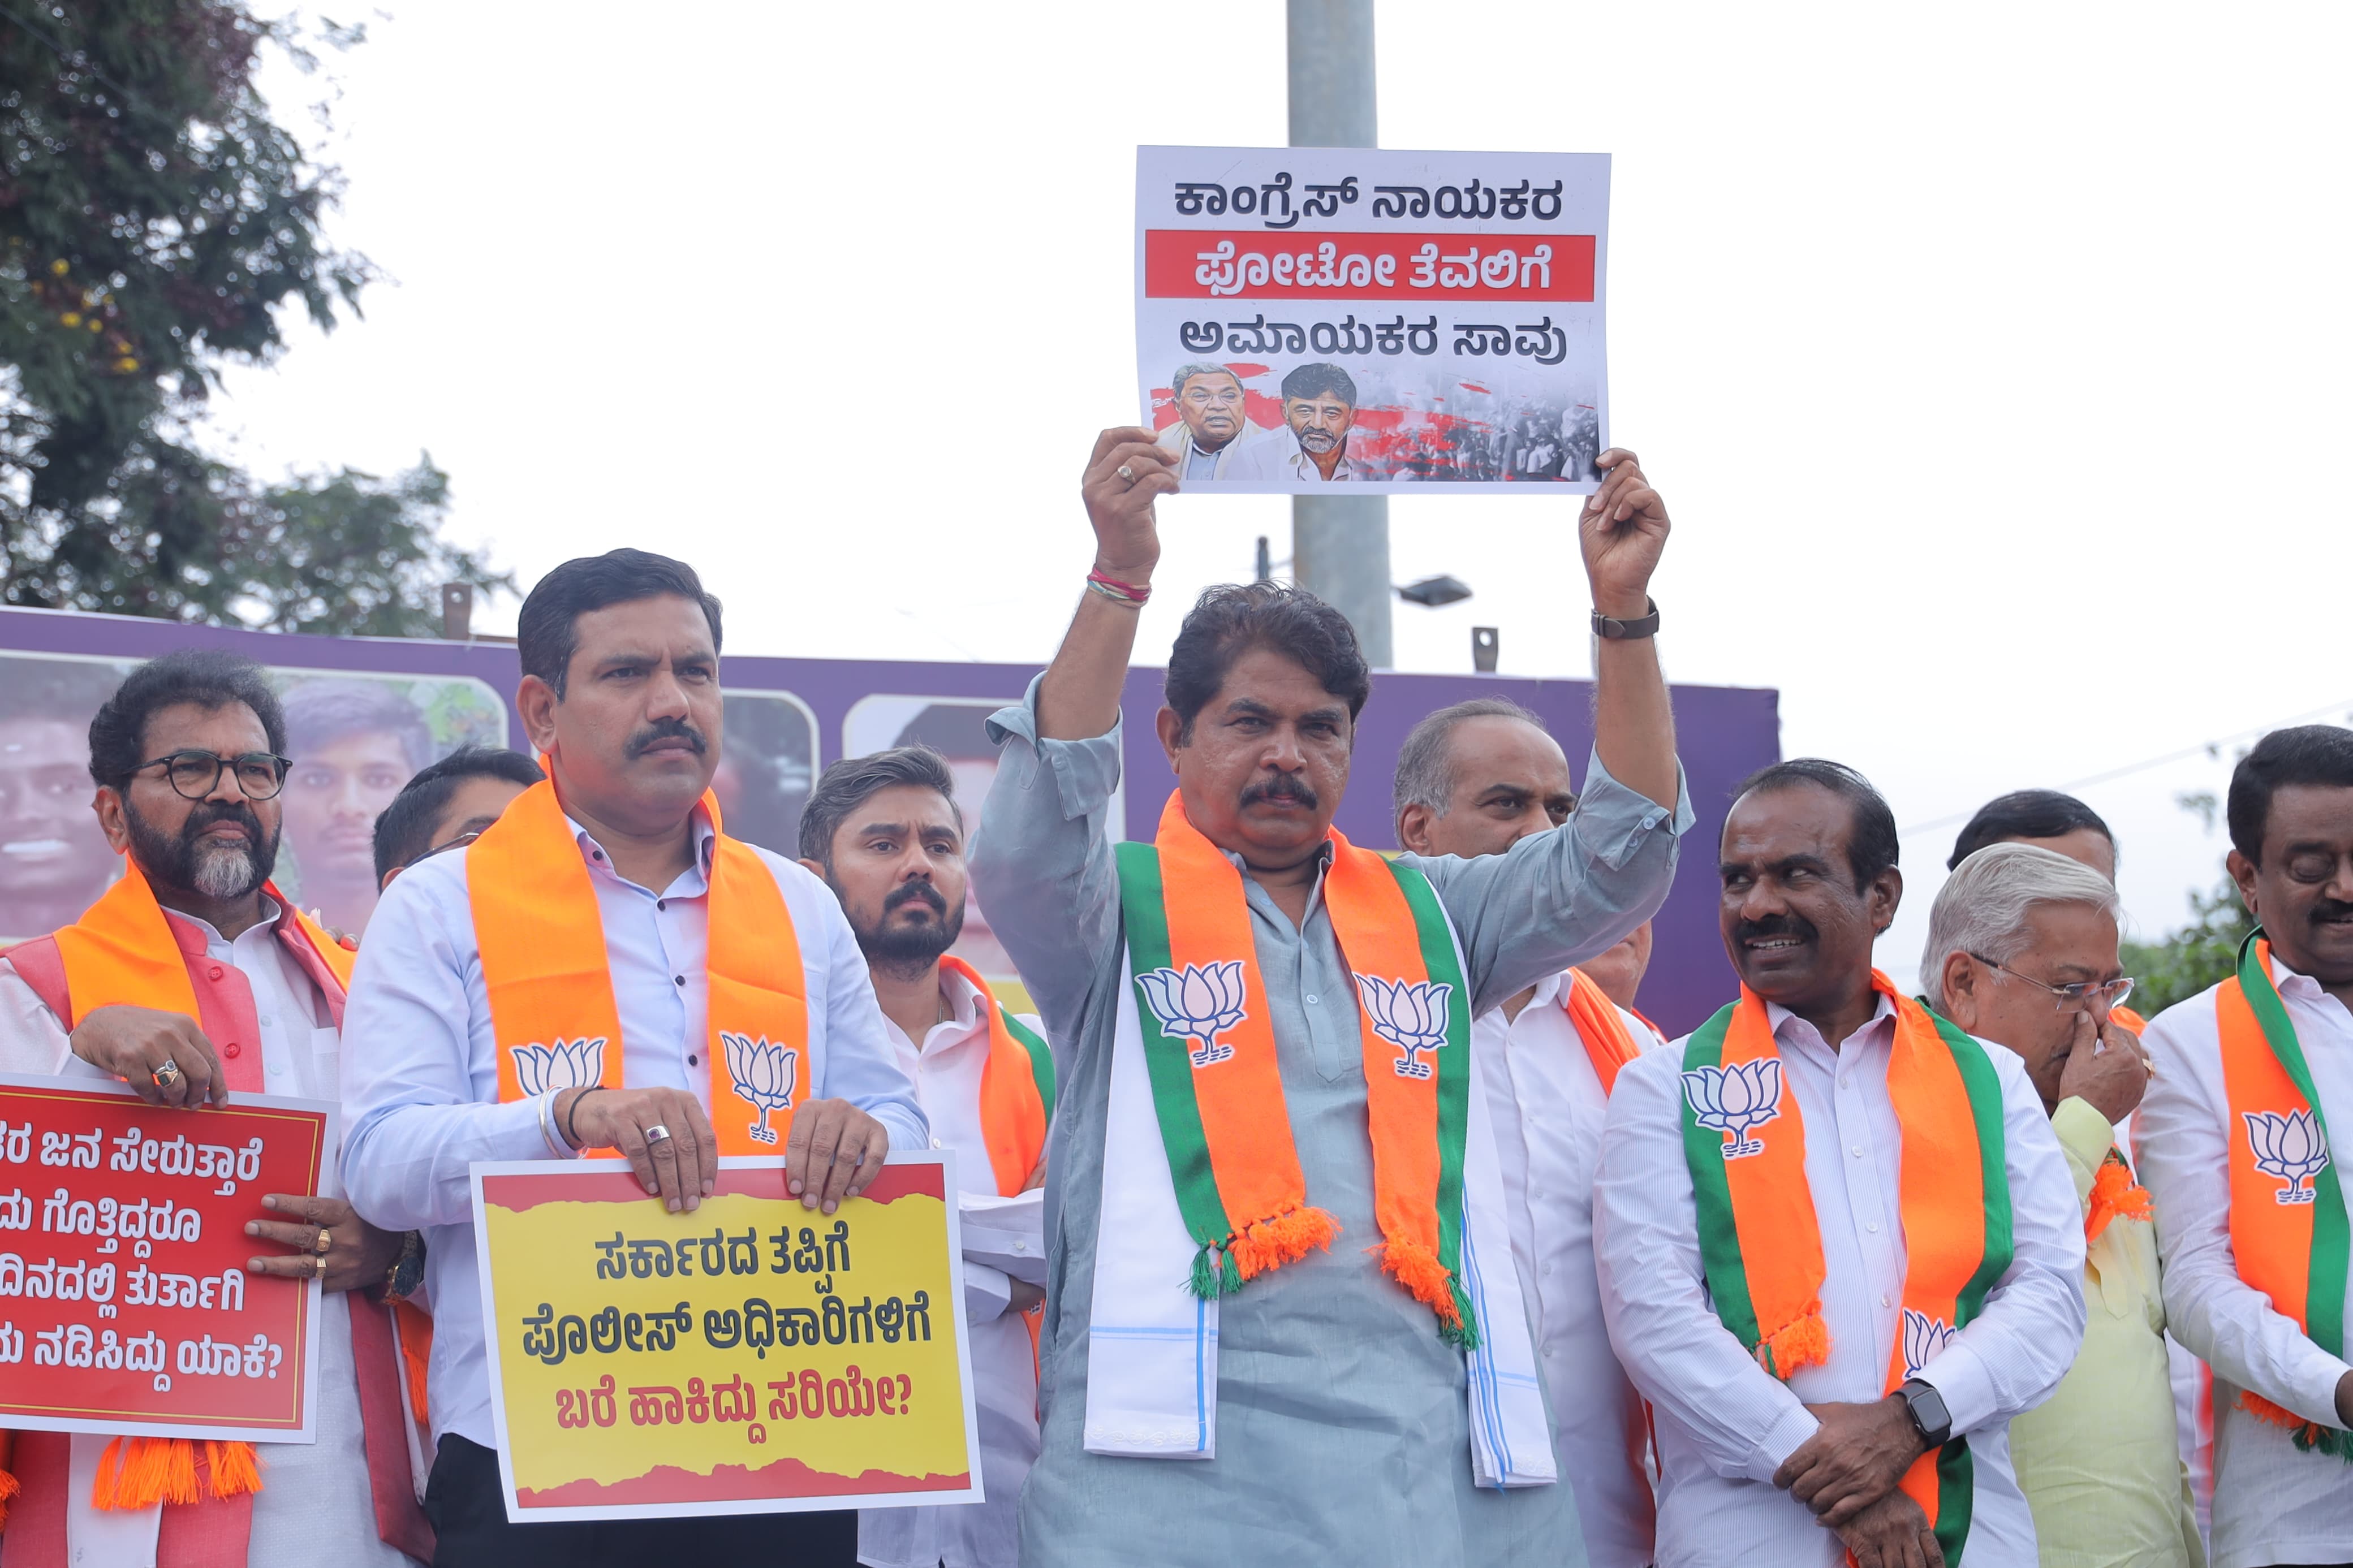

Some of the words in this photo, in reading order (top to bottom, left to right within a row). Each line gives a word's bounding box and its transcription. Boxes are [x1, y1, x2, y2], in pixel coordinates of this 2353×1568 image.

[1175, 172, 1358, 228] ಕಾಂಗ್ರೆಸ್
[1373, 179, 1562, 220] ನಾಯಕರ
[1196, 241, 1395, 295] ಫೋಟೋ
[1410, 243, 1552, 288] ತೆವಲಿಗೆ
[1180, 314, 1437, 355] ಅಮಾಯಕರ
[1454, 317, 1566, 365] ಸಾವು
[41, 1129, 101, 1168] ಜನ
[111, 1128, 262, 1195] ಸೇರುತ್ತಾರೆ
[43, 1189, 200, 1258] ಗೊತ್ತಿದ್ದರೂ
[125, 1264, 243, 1311] ತುರ್ತಾಗಿ
[596, 1228, 759, 1278] ಸರ್ಕಾರದ
[769, 1221, 850, 1294] ತಪ್ಪಿಗೆ
[35, 1324, 171, 1392] ನಡಿಸಿದ್ದು
[178, 1334, 282, 1379] ಯಾಕೆ?
[523, 1302, 692, 1364] ಪೊಲೀಸ್
[704, 1290, 930, 1359] ಅಧಿಕಾರಿಗಳಿಗೆ
[557, 1375, 616, 1428] ಬರೆ
[628, 1374, 766, 1444] ಹಾಕಿದ್ದು
[768, 1365, 911, 1419] ಸರಿಯೇ?
